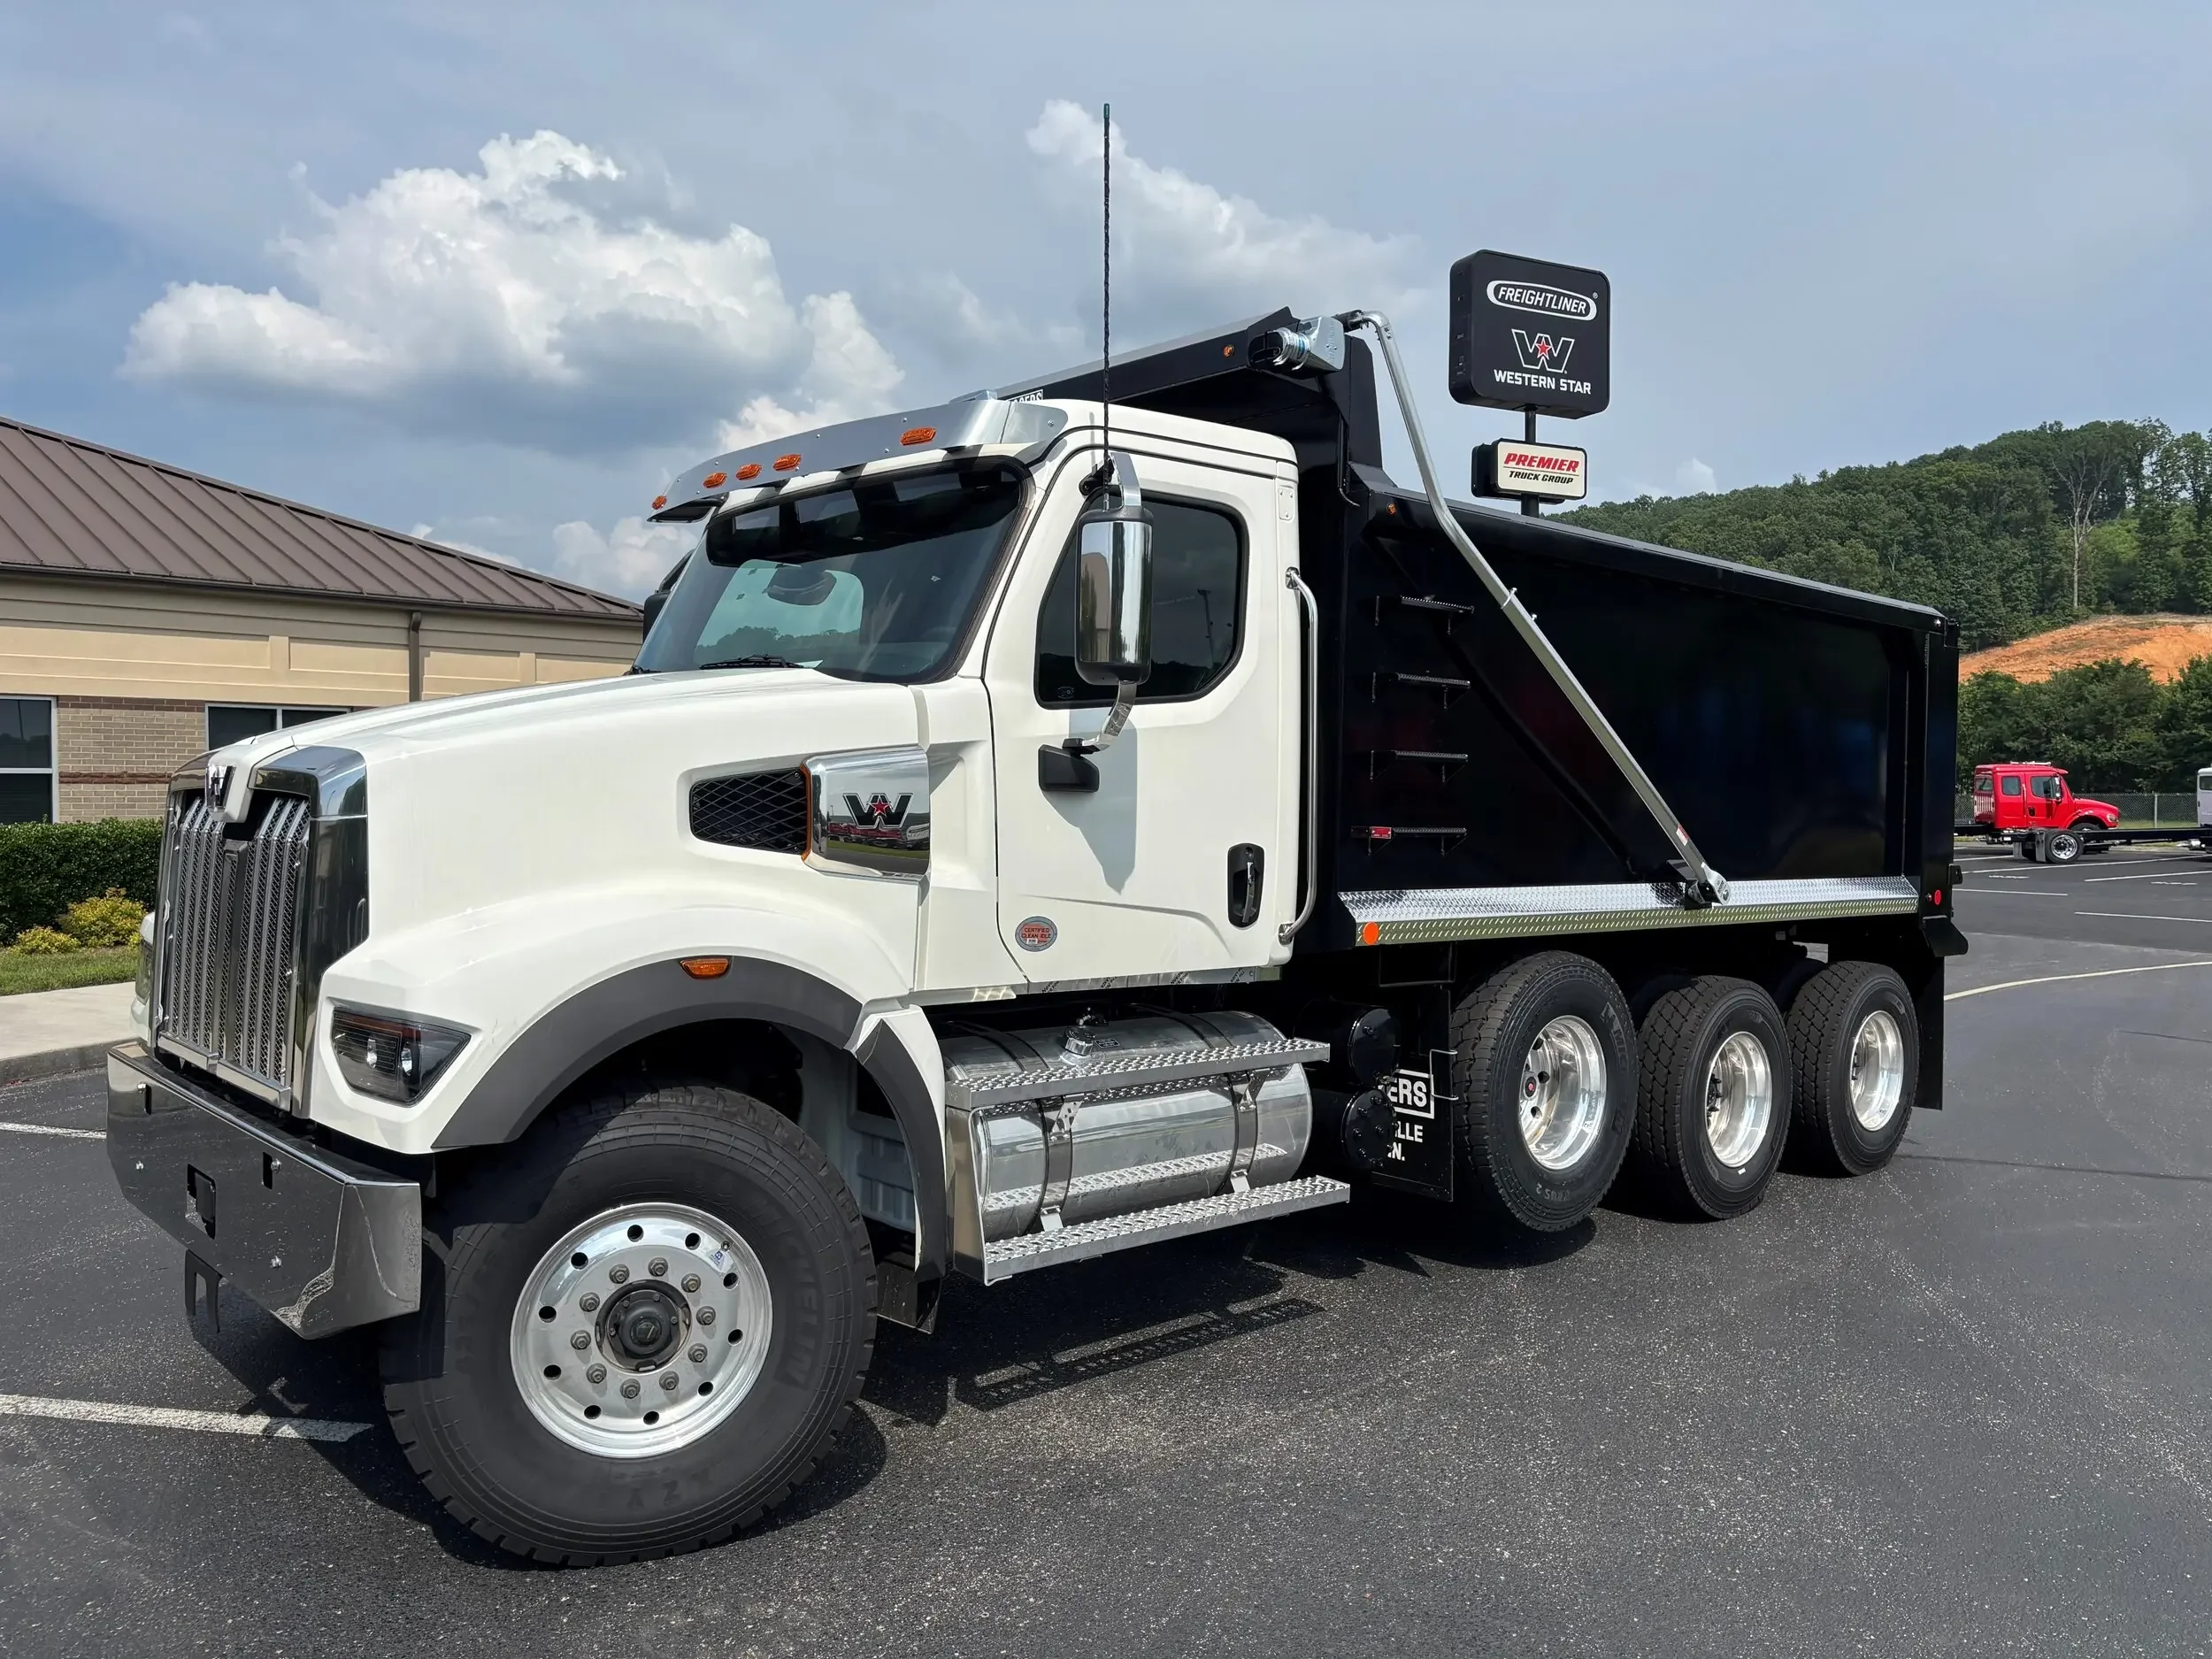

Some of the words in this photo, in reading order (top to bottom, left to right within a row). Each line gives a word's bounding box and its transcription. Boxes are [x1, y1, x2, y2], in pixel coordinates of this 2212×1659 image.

[1498, 286, 1586, 314] FREIGHTLINER
[1494, 369, 1555, 390] WESTERN
[1560, 378, 1592, 395] STAR
[1504, 452, 1579, 472] PREMIER
[1509, 471, 1540, 481] TRUCK
[1541, 474, 1573, 484] GROUP
[1386, 1077, 1427, 1108] ERS
[1395, 1120, 1424, 1143] LLE
